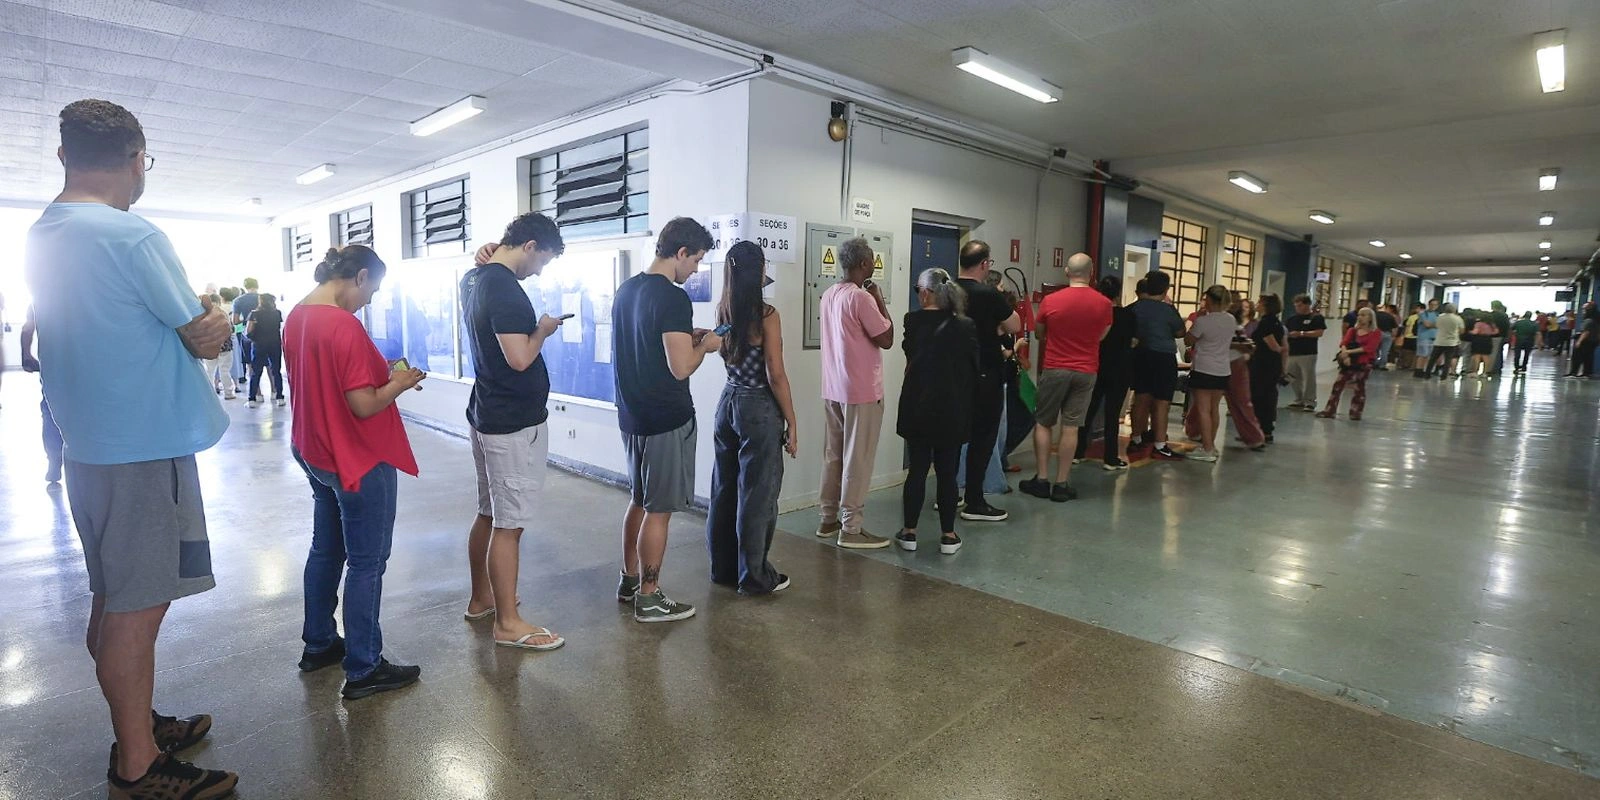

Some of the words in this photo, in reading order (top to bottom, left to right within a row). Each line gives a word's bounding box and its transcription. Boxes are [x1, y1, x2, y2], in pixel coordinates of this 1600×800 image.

[712, 219, 739, 229] SEES
[759, 218, 788, 229] SEÇÕES
[757, 237, 768, 249] 30
[770, 241, 776, 249] a
[778, 239, 789, 250] 36
